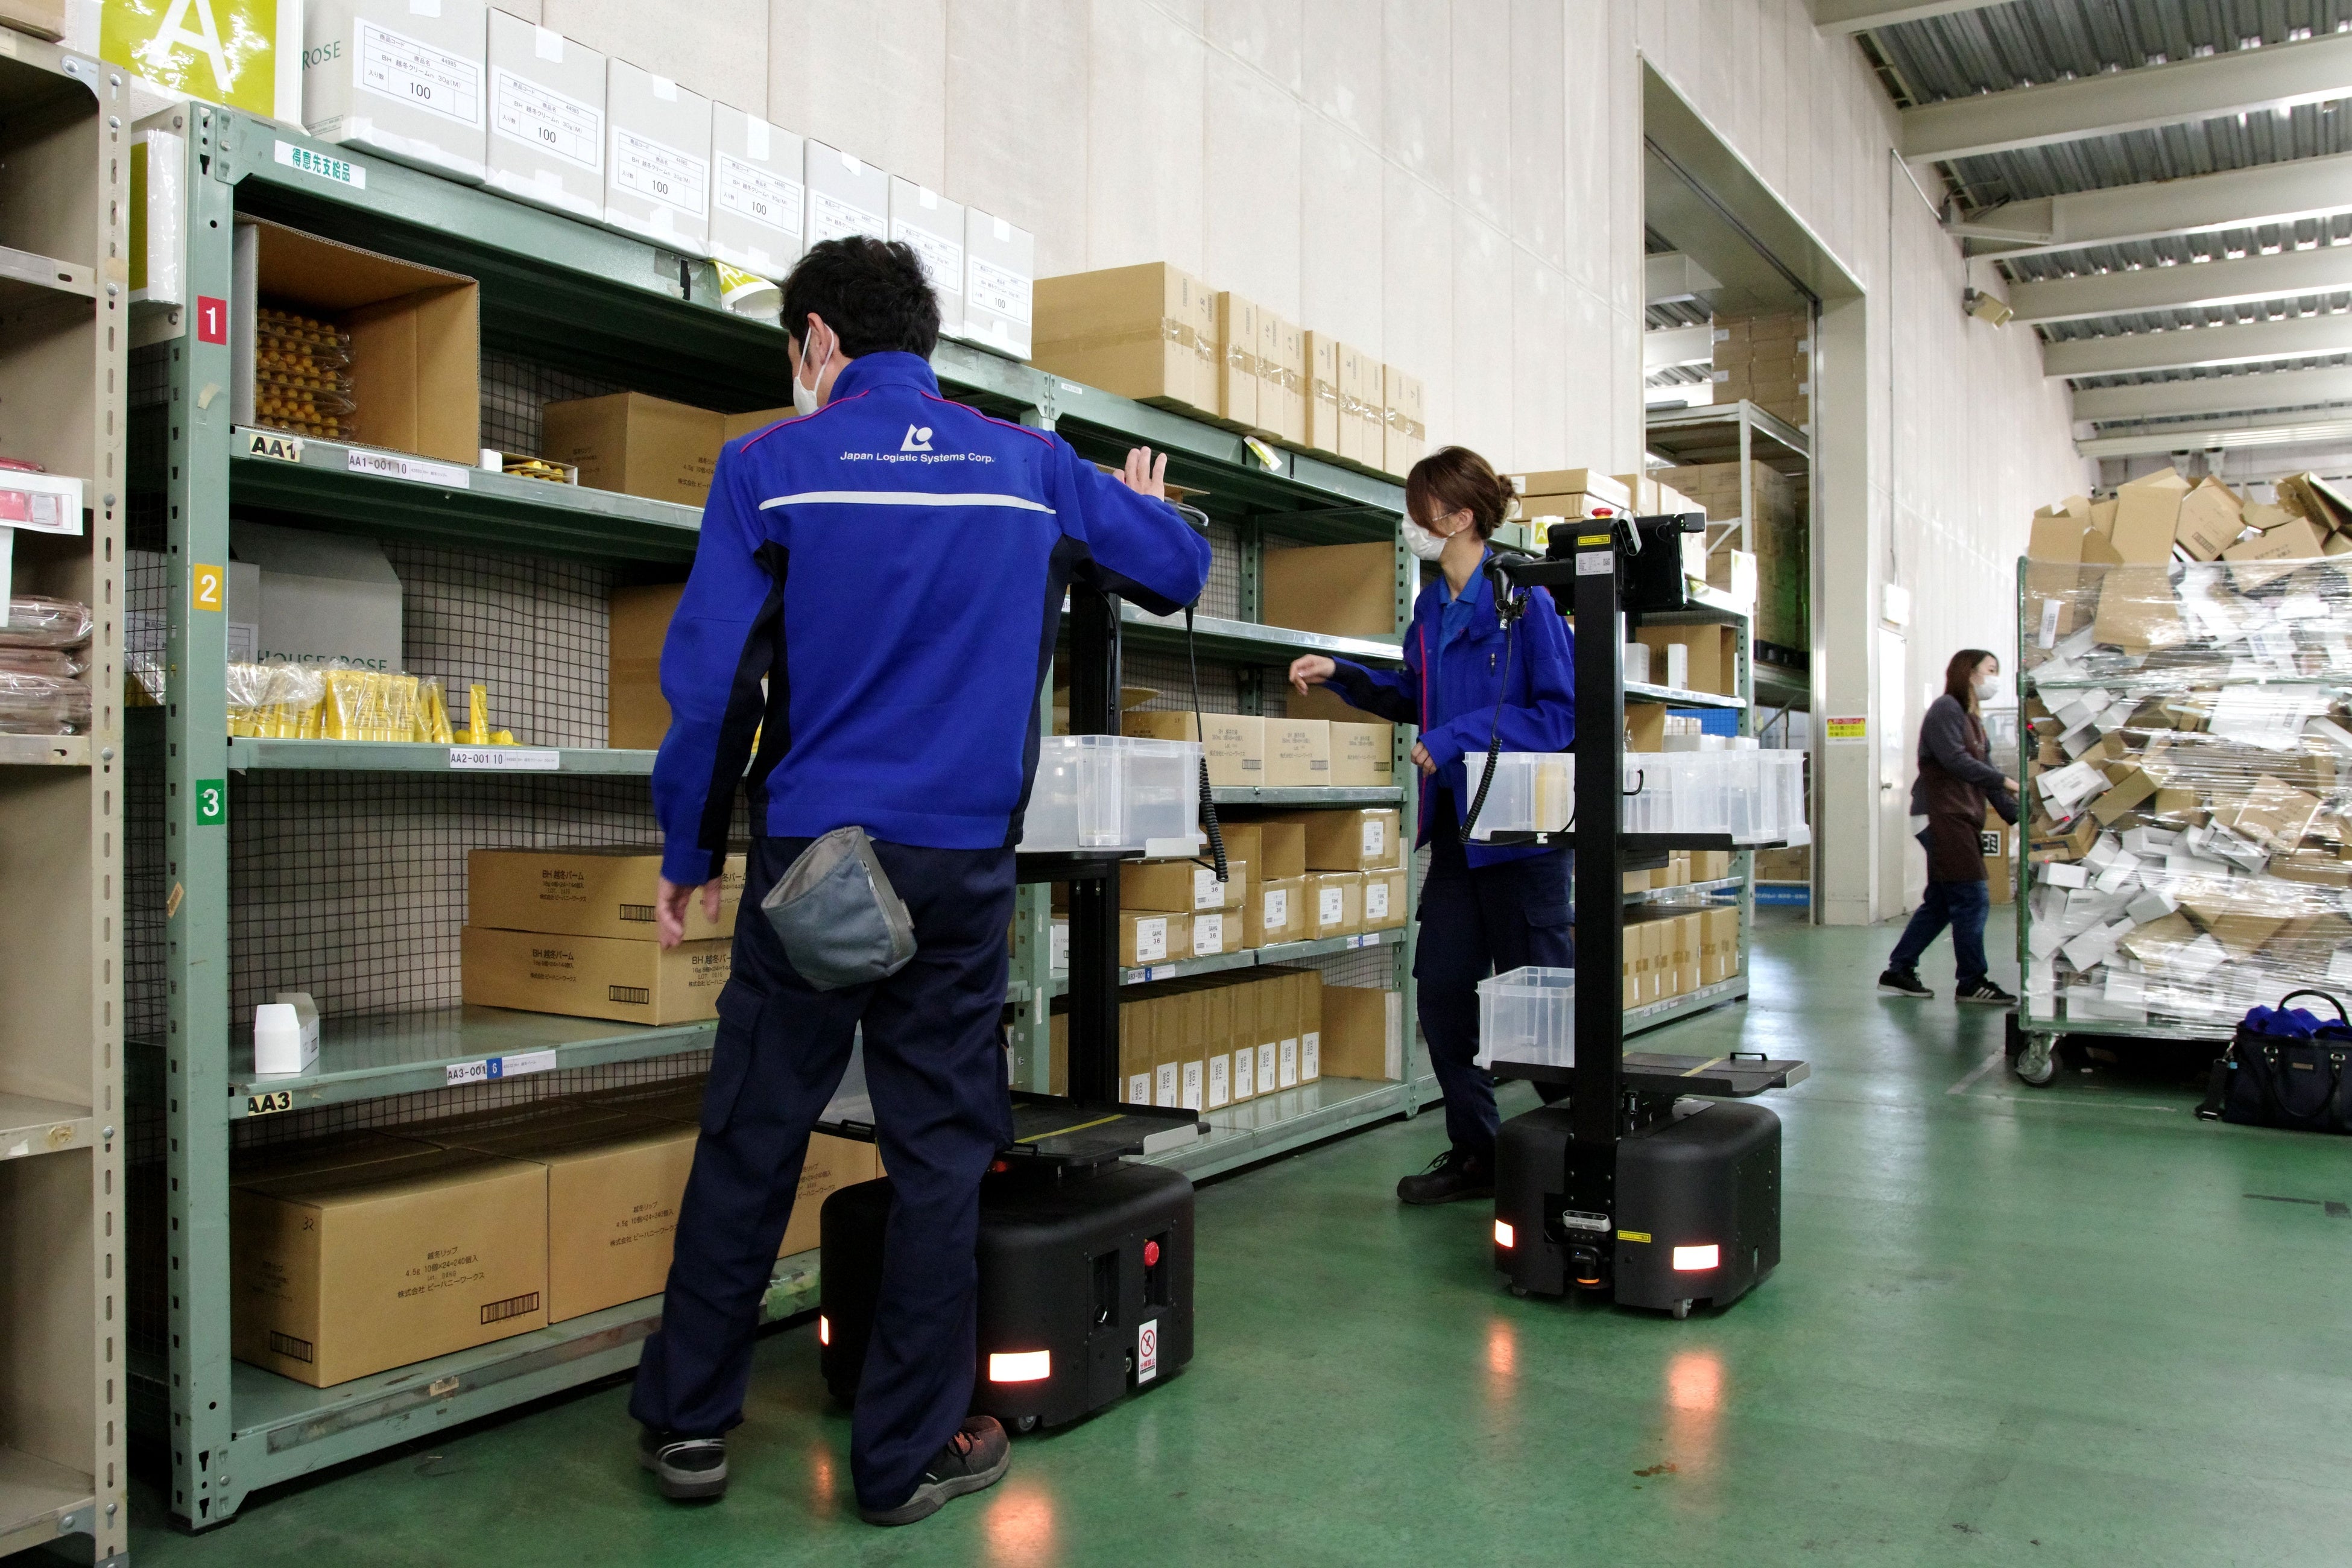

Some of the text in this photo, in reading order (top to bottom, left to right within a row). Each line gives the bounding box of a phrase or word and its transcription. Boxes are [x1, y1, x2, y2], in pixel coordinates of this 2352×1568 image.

[145, 0, 234, 93] A
[379, 34, 405, 48] 商品コード
[382, 54, 392, 63] BH
[414, 55, 431, 67] 商品名
[441, 57, 457, 68] 44985
[368, 70, 384, 80] 入り数
[410, 82, 431, 100] 100
[538, 127, 556, 143] 100
[292, 147, 350, 183] 得意先支給品
[653, 180, 668, 195] 100
[753, 201, 767, 215] 100
[206, 307, 215, 335] 1
[251, 437, 296, 460] AA1
[349, 455, 391, 471] AA1-001
[396, 463, 406, 475] 10
[840, 451, 994, 464] Japan Logistic Systems Corp.
[200, 574, 217, 602] 2
[451, 754, 489, 763] AA2-001
[494, 754, 503, 764] 10
[203, 788, 219, 817] 3
[692, 956, 703, 964] BH
[447, 1066, 486, 1080] AA3-001
[492, 1063, 497, 1073] 6
[248, 1092, 290, 1113] AA3
[428, 1247, 458, 1260] 越冬リップ
[397, 1272, 485, 1298] 株式会社 ビーハニーワークス
